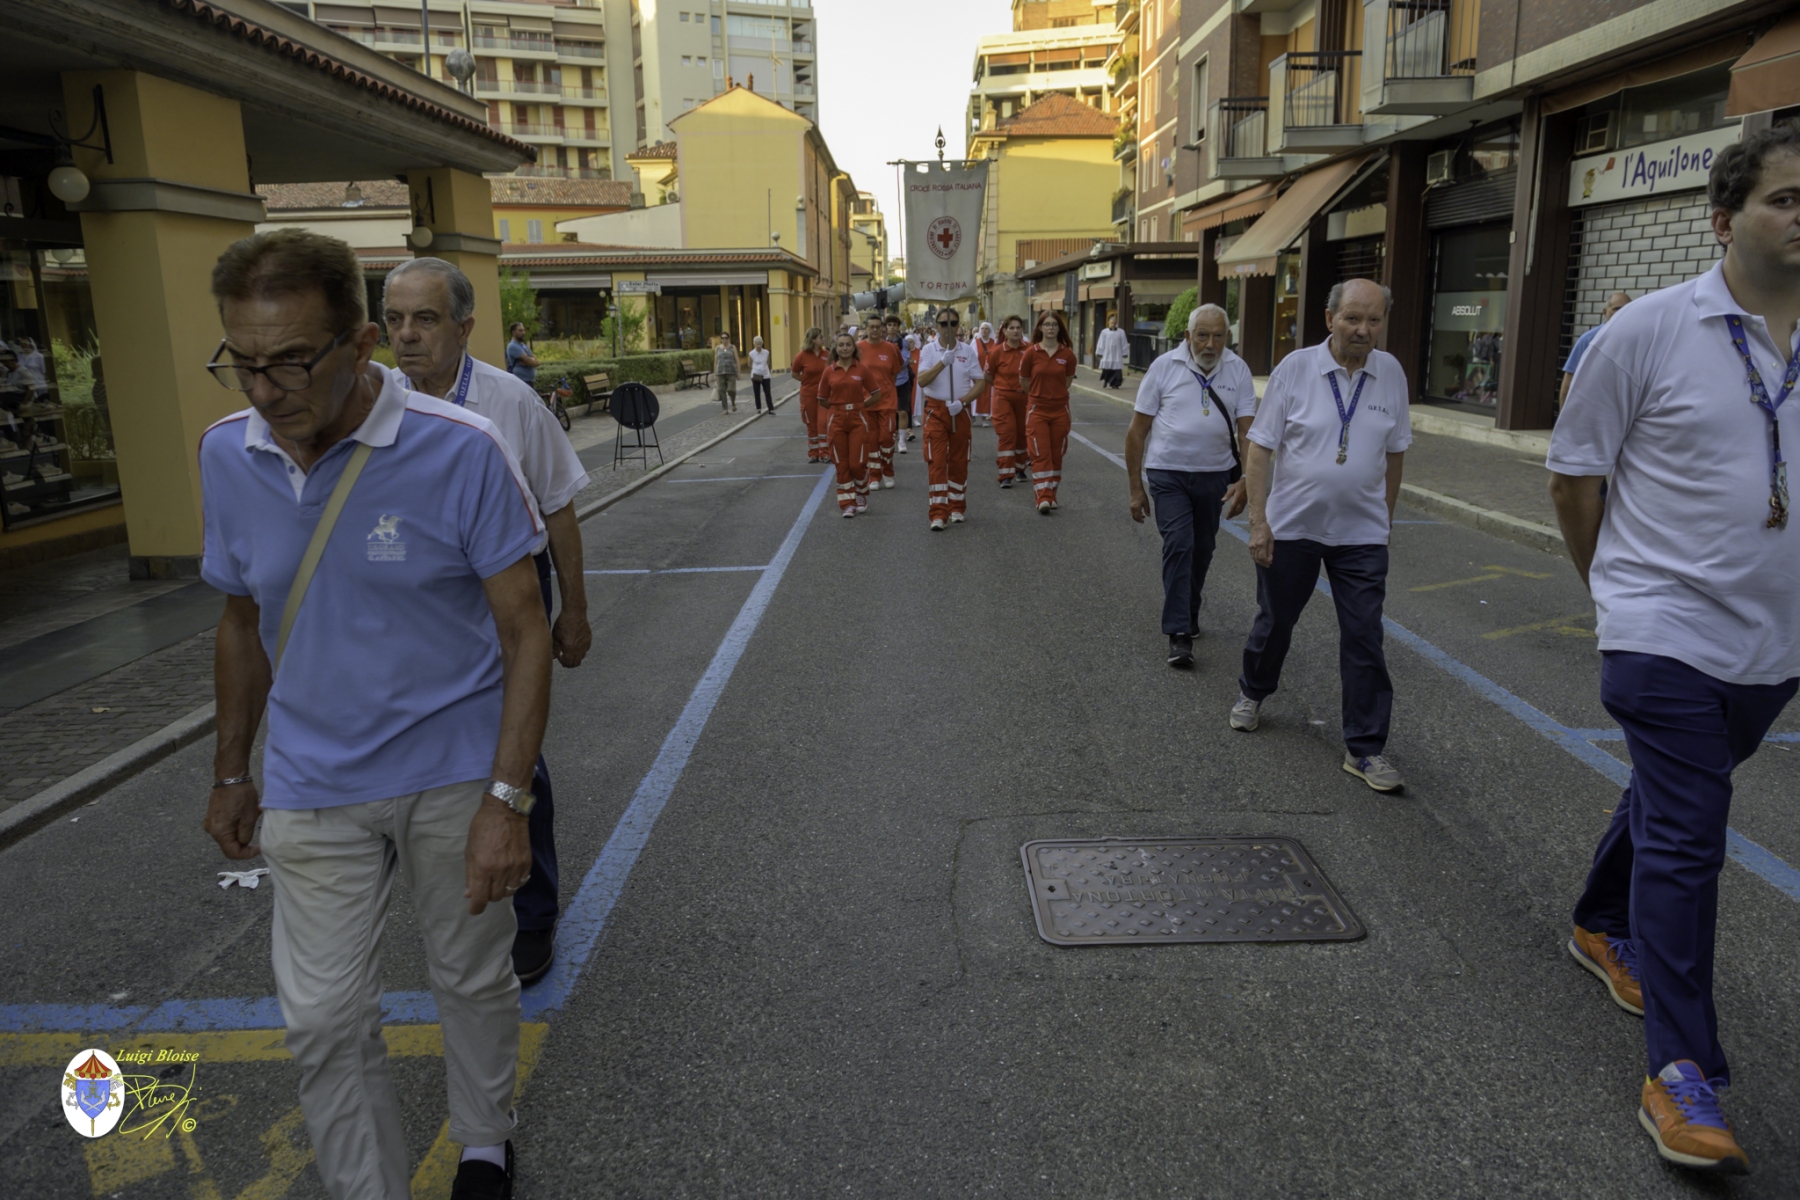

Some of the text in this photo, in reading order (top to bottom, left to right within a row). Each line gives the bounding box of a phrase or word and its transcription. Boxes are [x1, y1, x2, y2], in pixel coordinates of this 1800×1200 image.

[1622, 145, 1713, 192] l'Aquilone
[909, 181, 982, 193] CROCE ROSSA ITALIANA
[919, 280, 968, 290] TORTONA
[1451, 305, 1482, 316] ABSOLUT
[1071, 888, 1190, 903] TORTONA
